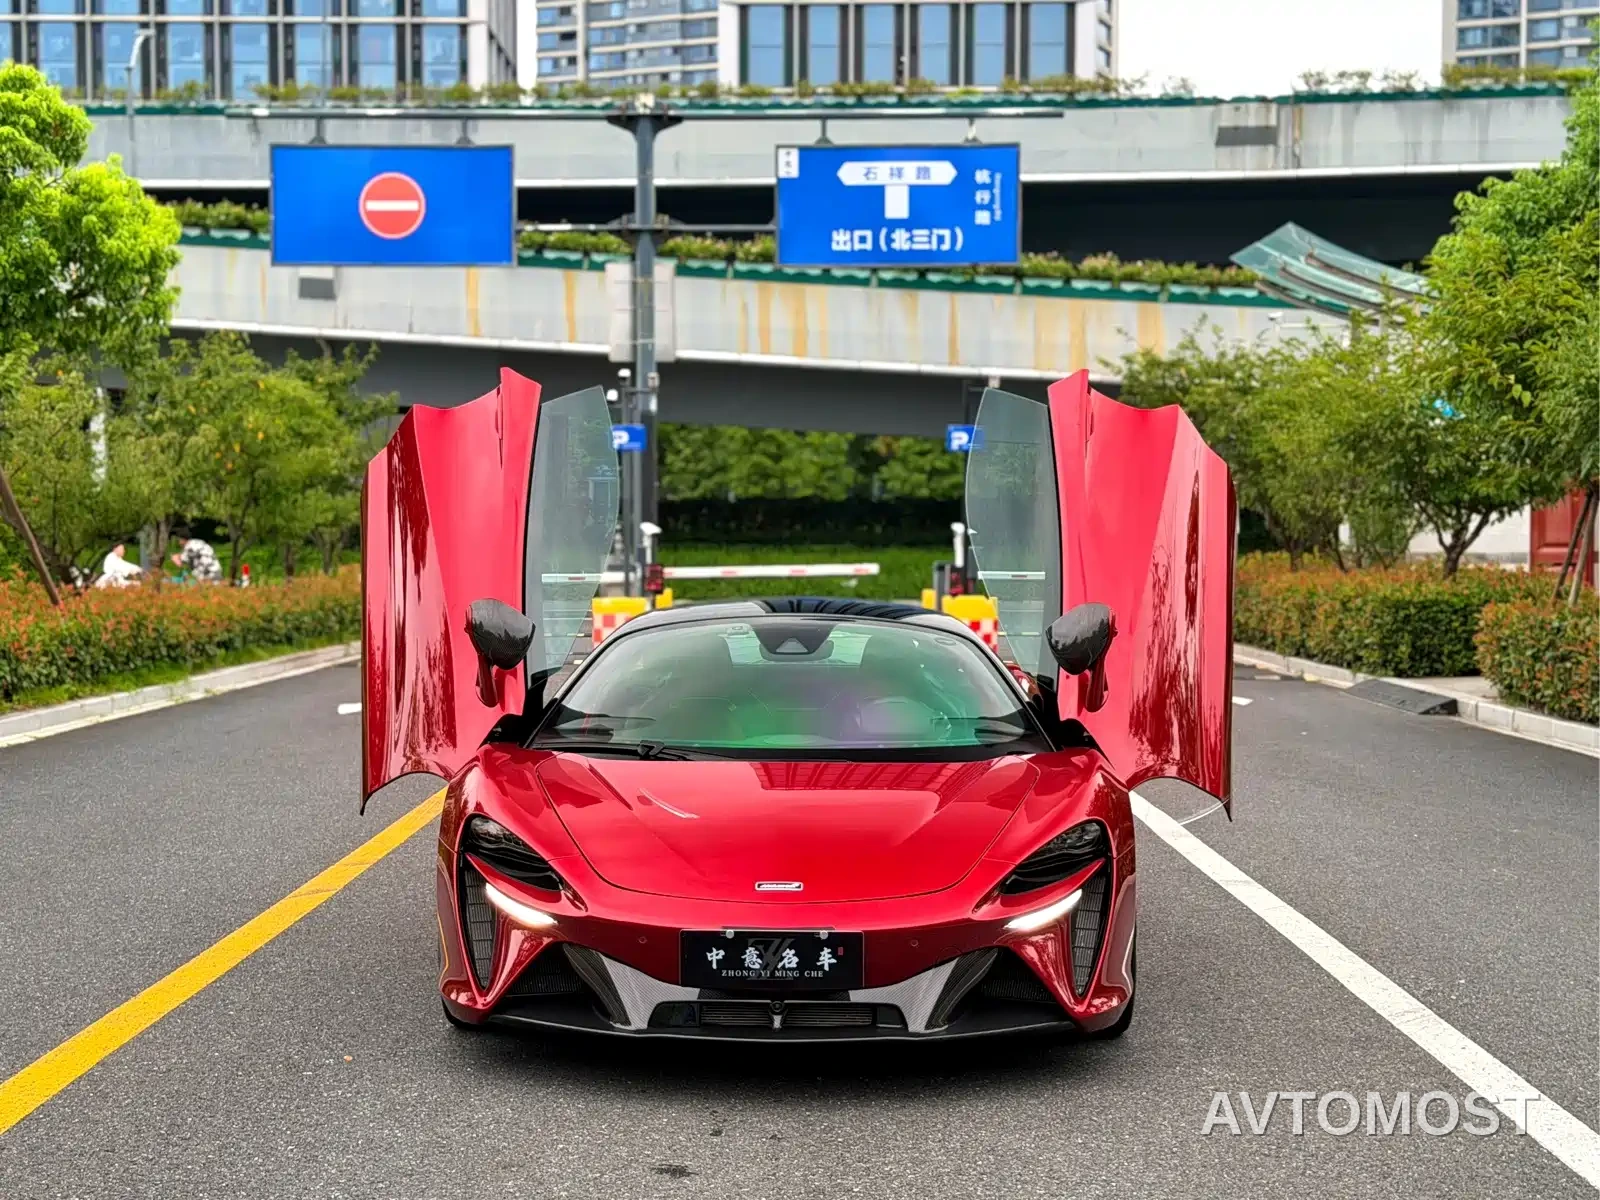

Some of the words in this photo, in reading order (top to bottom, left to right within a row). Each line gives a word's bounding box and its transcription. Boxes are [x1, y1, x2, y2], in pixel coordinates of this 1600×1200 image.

[951, 431, 970, 451] P
[705, 946, 838, 971] 中意名车
[721, 969, 756, 978] ZHONG
[759, 969, 771, 978] YI
[774, 969, 800, 978] MING
[804, 969, 824, 978] CHE
